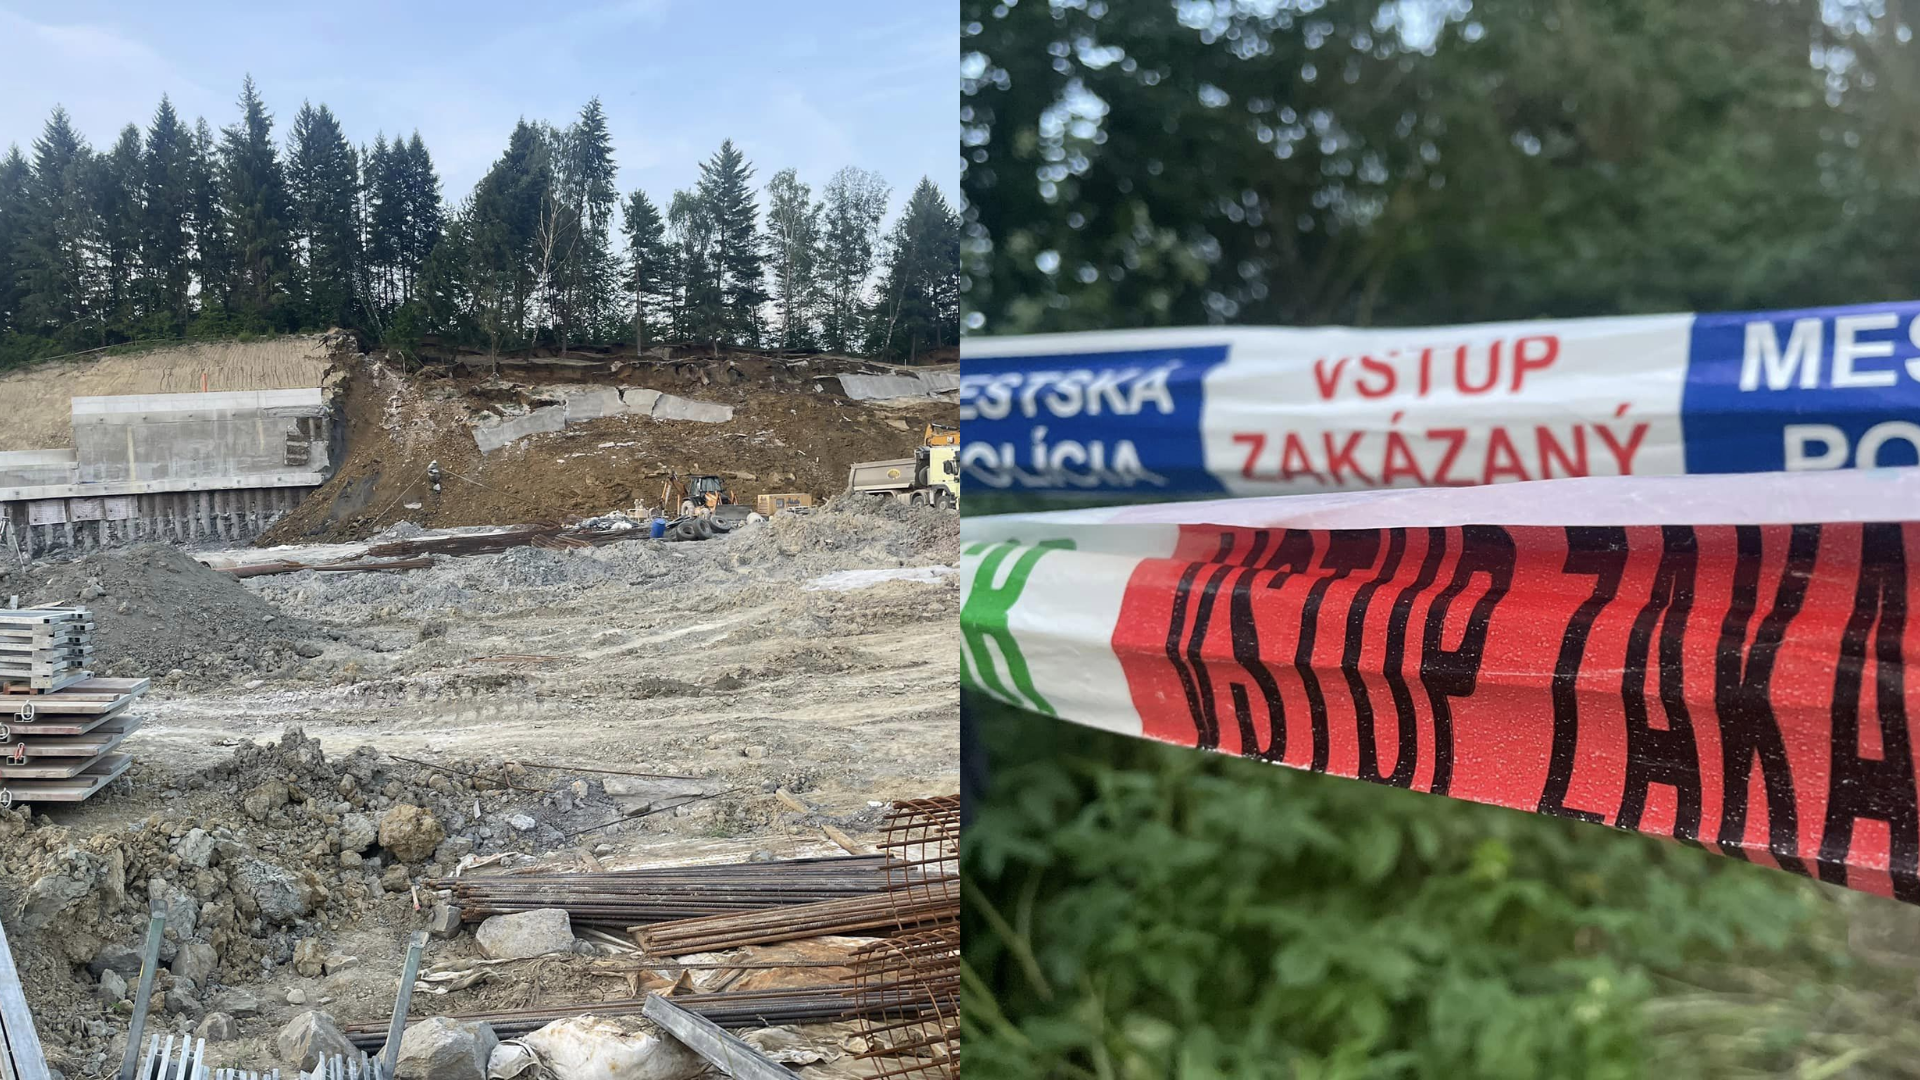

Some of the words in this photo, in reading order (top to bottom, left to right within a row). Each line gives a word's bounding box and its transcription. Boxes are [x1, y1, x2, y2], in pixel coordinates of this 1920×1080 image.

[1313, 335, 1560, 400] VSTUP
[1739, 311, 1920, 391] ME
[1231, 402, 1650, 488] ZAKÁZANÝ
[1165, 524, 1517, 797] VSTUP
